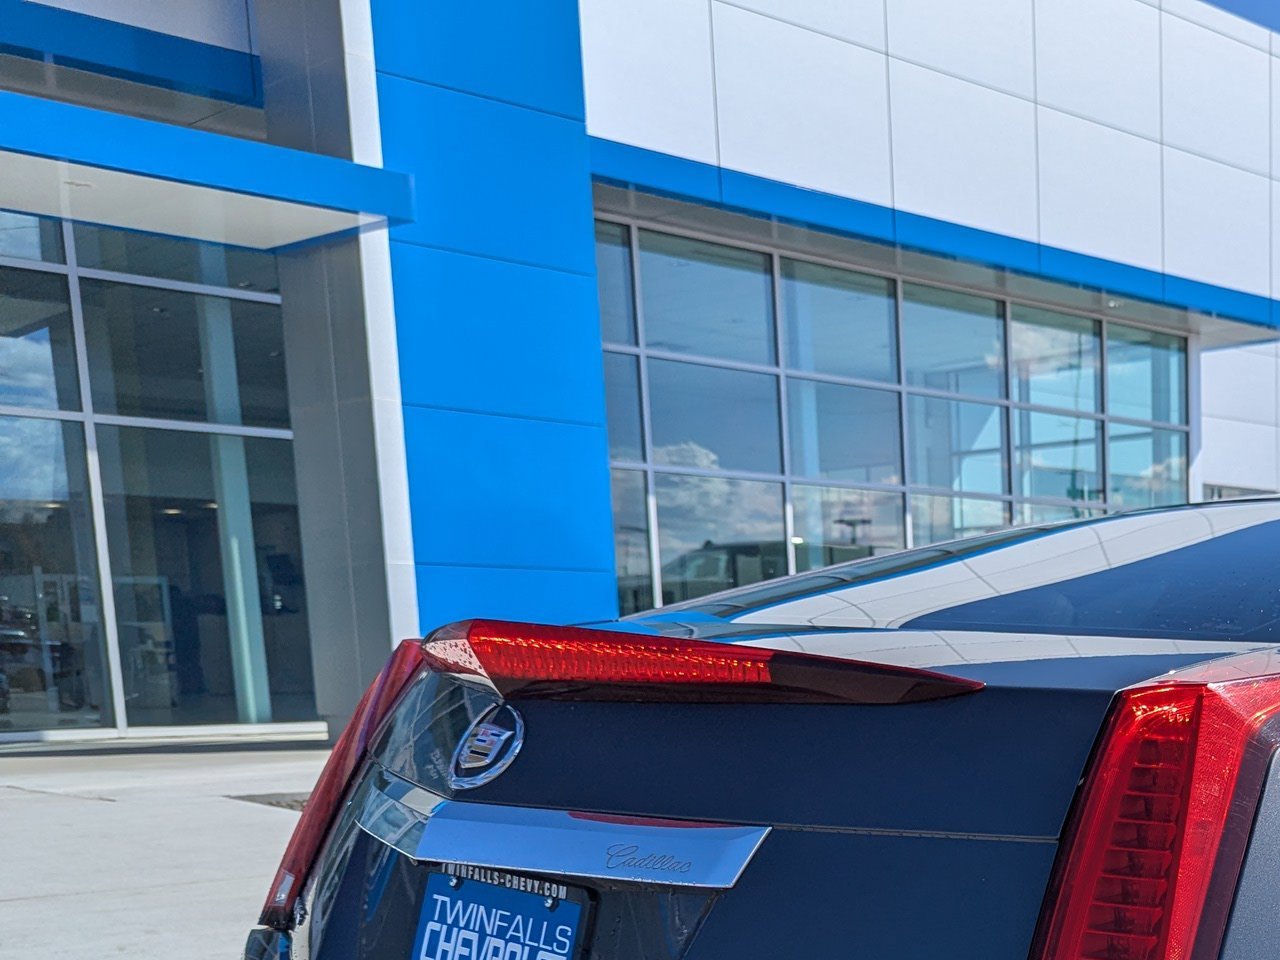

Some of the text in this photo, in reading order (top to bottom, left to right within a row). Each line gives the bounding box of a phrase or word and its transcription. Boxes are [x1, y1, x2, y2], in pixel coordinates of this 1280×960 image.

[606, 843, 692, 873] Cadillac
[441, 863, 567, 899] TWINFALLS-CHEVY.COM
[433, 894, 572, 954] TWINFALLS
